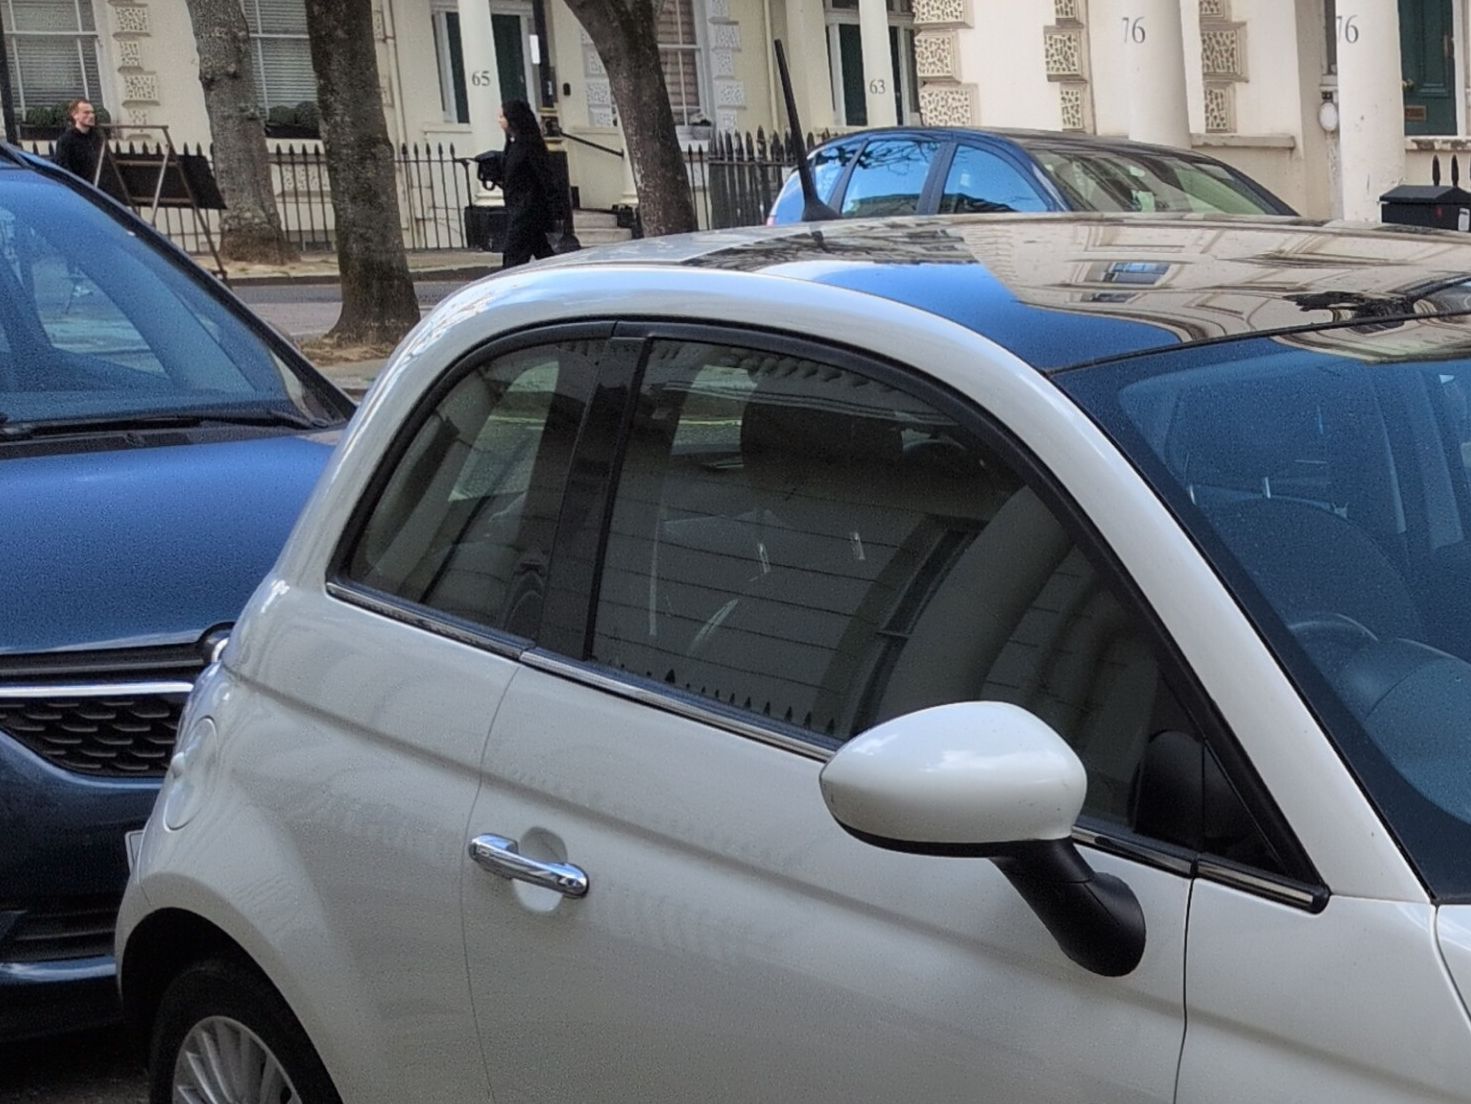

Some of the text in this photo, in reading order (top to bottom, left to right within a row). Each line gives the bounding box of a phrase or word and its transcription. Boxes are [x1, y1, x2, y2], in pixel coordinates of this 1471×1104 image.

[1121, 15, 1146, 44] 76
[1335, 14, 1359, 44] 76
[472, 70, 490, 87] 65
[869, 79, 886, 95] 63
